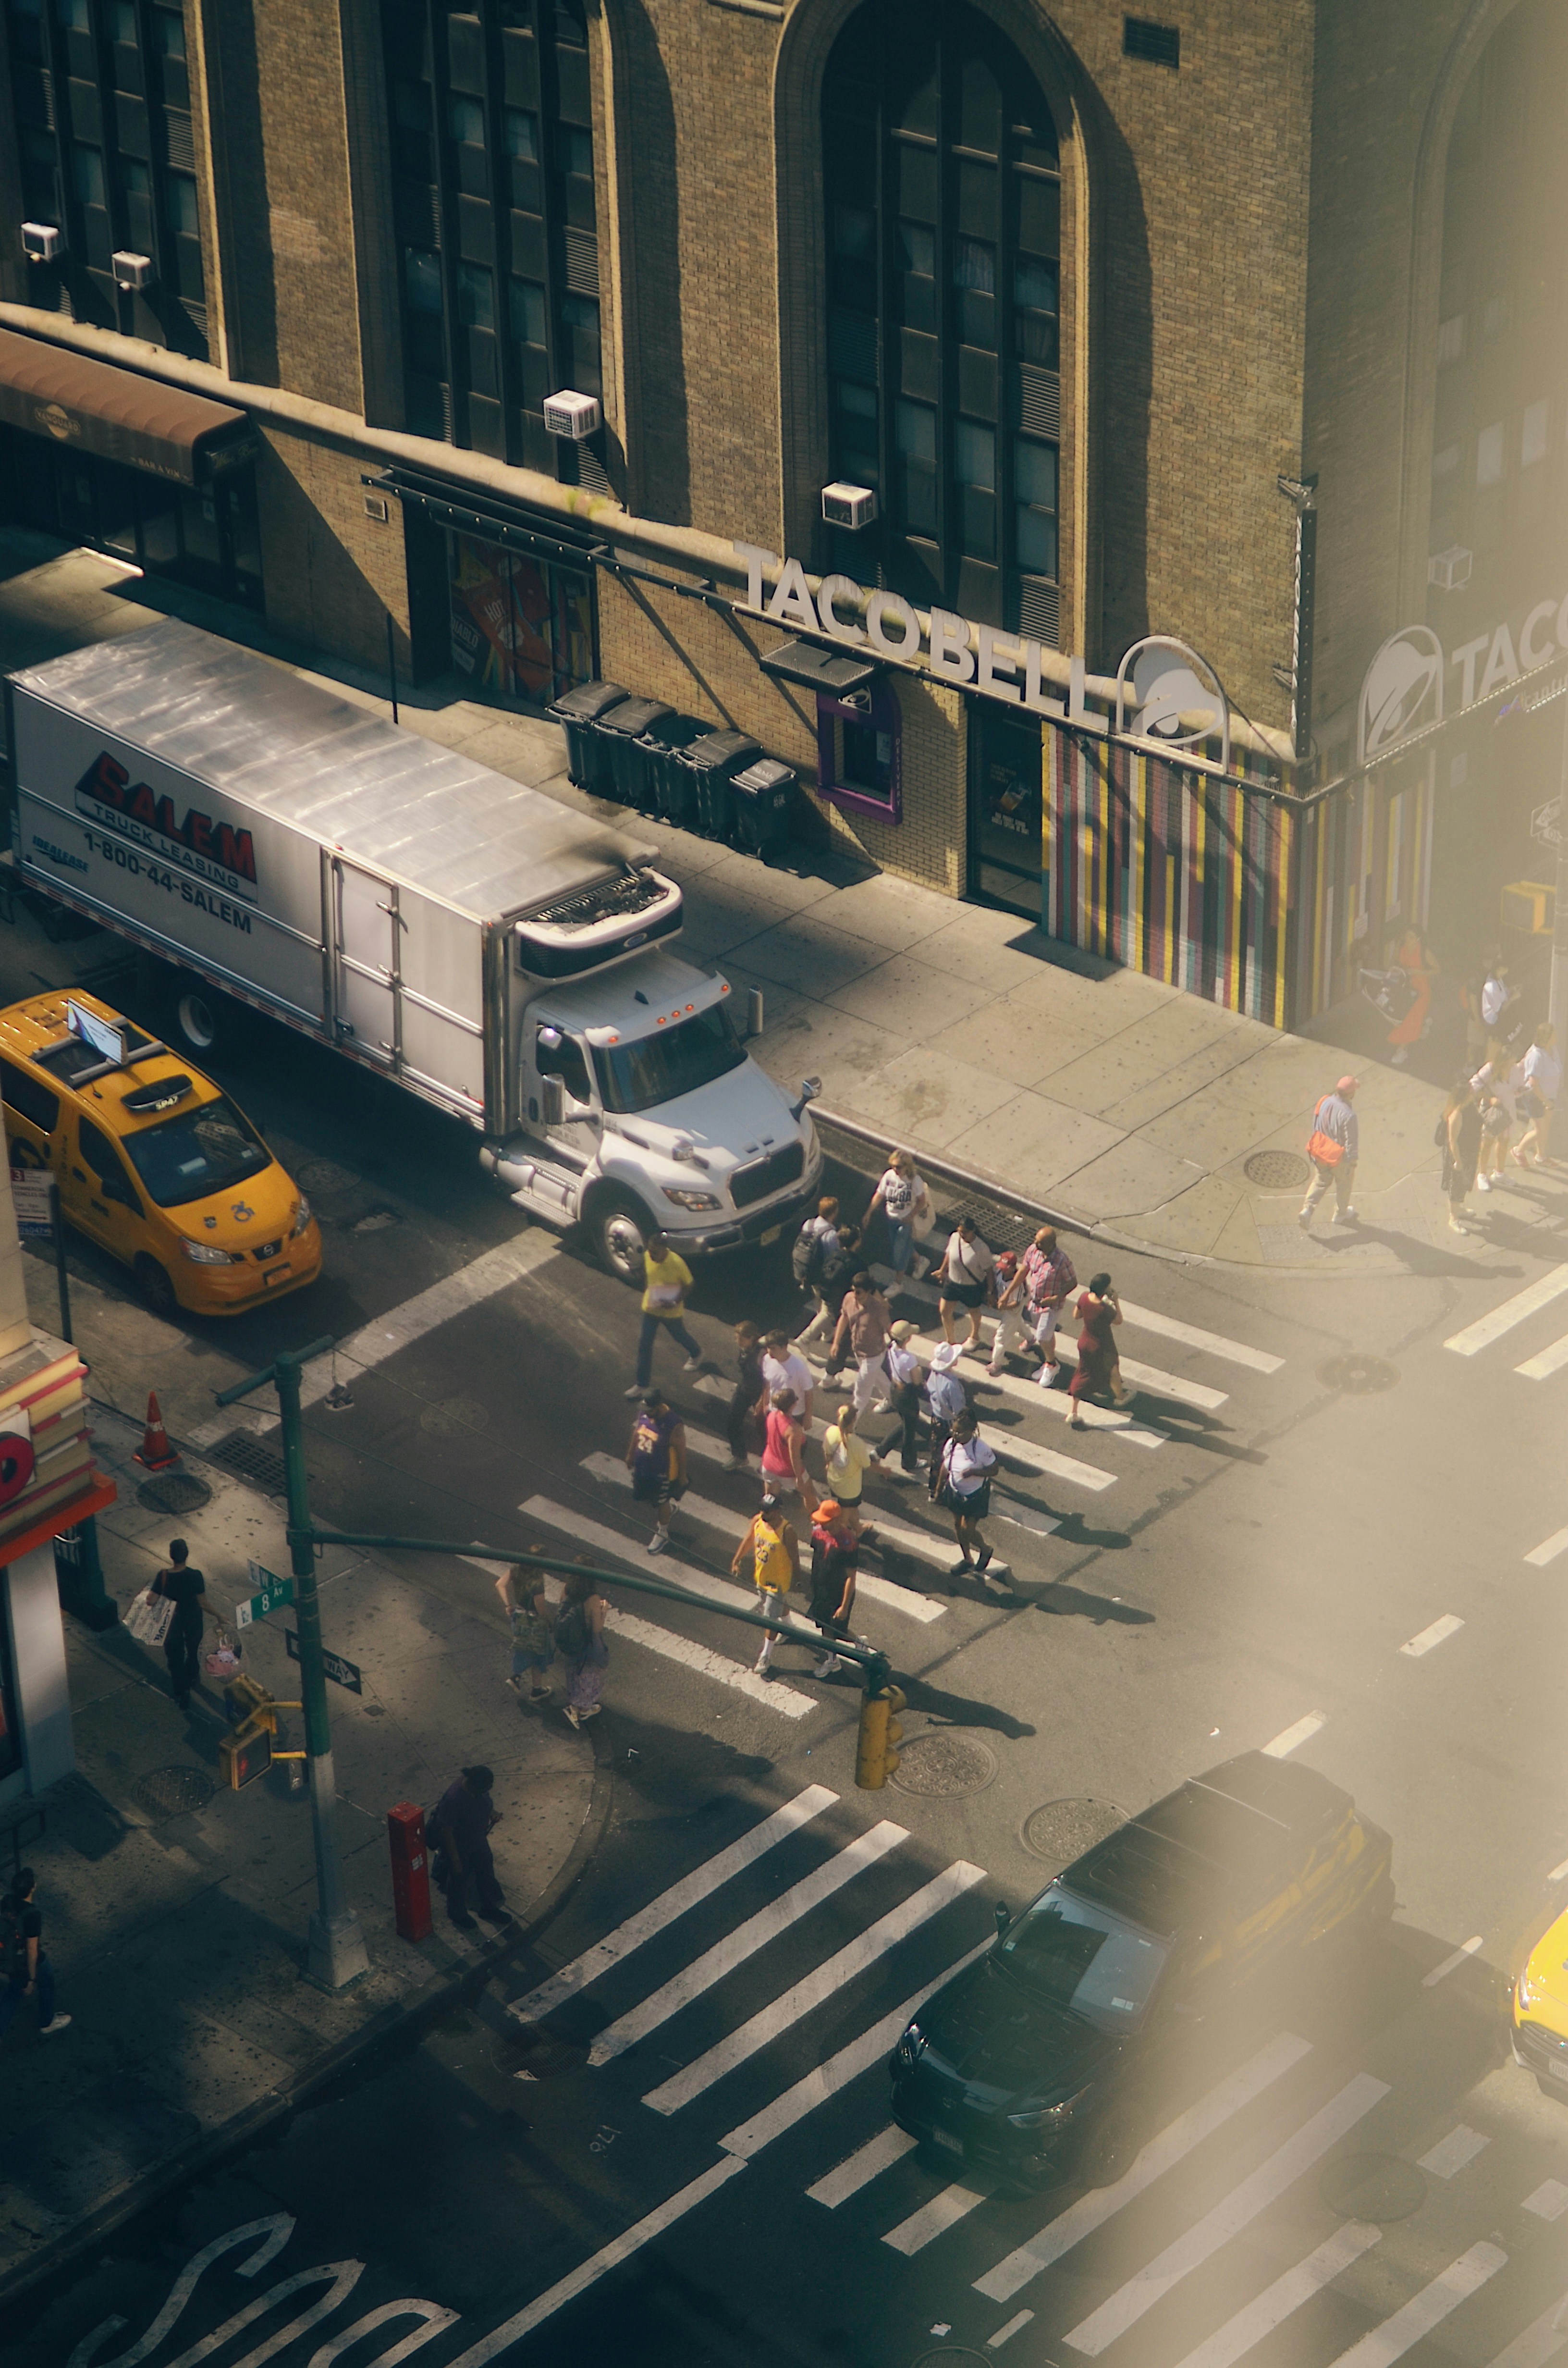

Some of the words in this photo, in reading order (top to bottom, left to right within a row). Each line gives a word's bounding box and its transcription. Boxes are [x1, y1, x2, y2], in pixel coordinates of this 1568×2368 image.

[36, 411, 79, 432] VANGUARD
[483, 599, 506, 623] HOT
[733, 539, 920, 661] TACO
[930, 605, 1109, 735] BELL
[1452, 590, 1568, 710] TAC
[81, 751, 257, 884] SALEM
[32, 835, 89, 873] IDEALEASE
[94, 803, 153, 844] TRUCK
[160, 839, 238, 888] LEASING
[84, 831, 251, 934] 1-800-44-SALEM
[14, 1170, 20, 1181] 3
[638, 1434, 652, 1454] 24
[757, 1546, 768, 1563] 23
[262, 1593, 270, 1612] 8
[273, 1587, 283, 1598] Av
[327, 1659, 349, 1679] WAY
